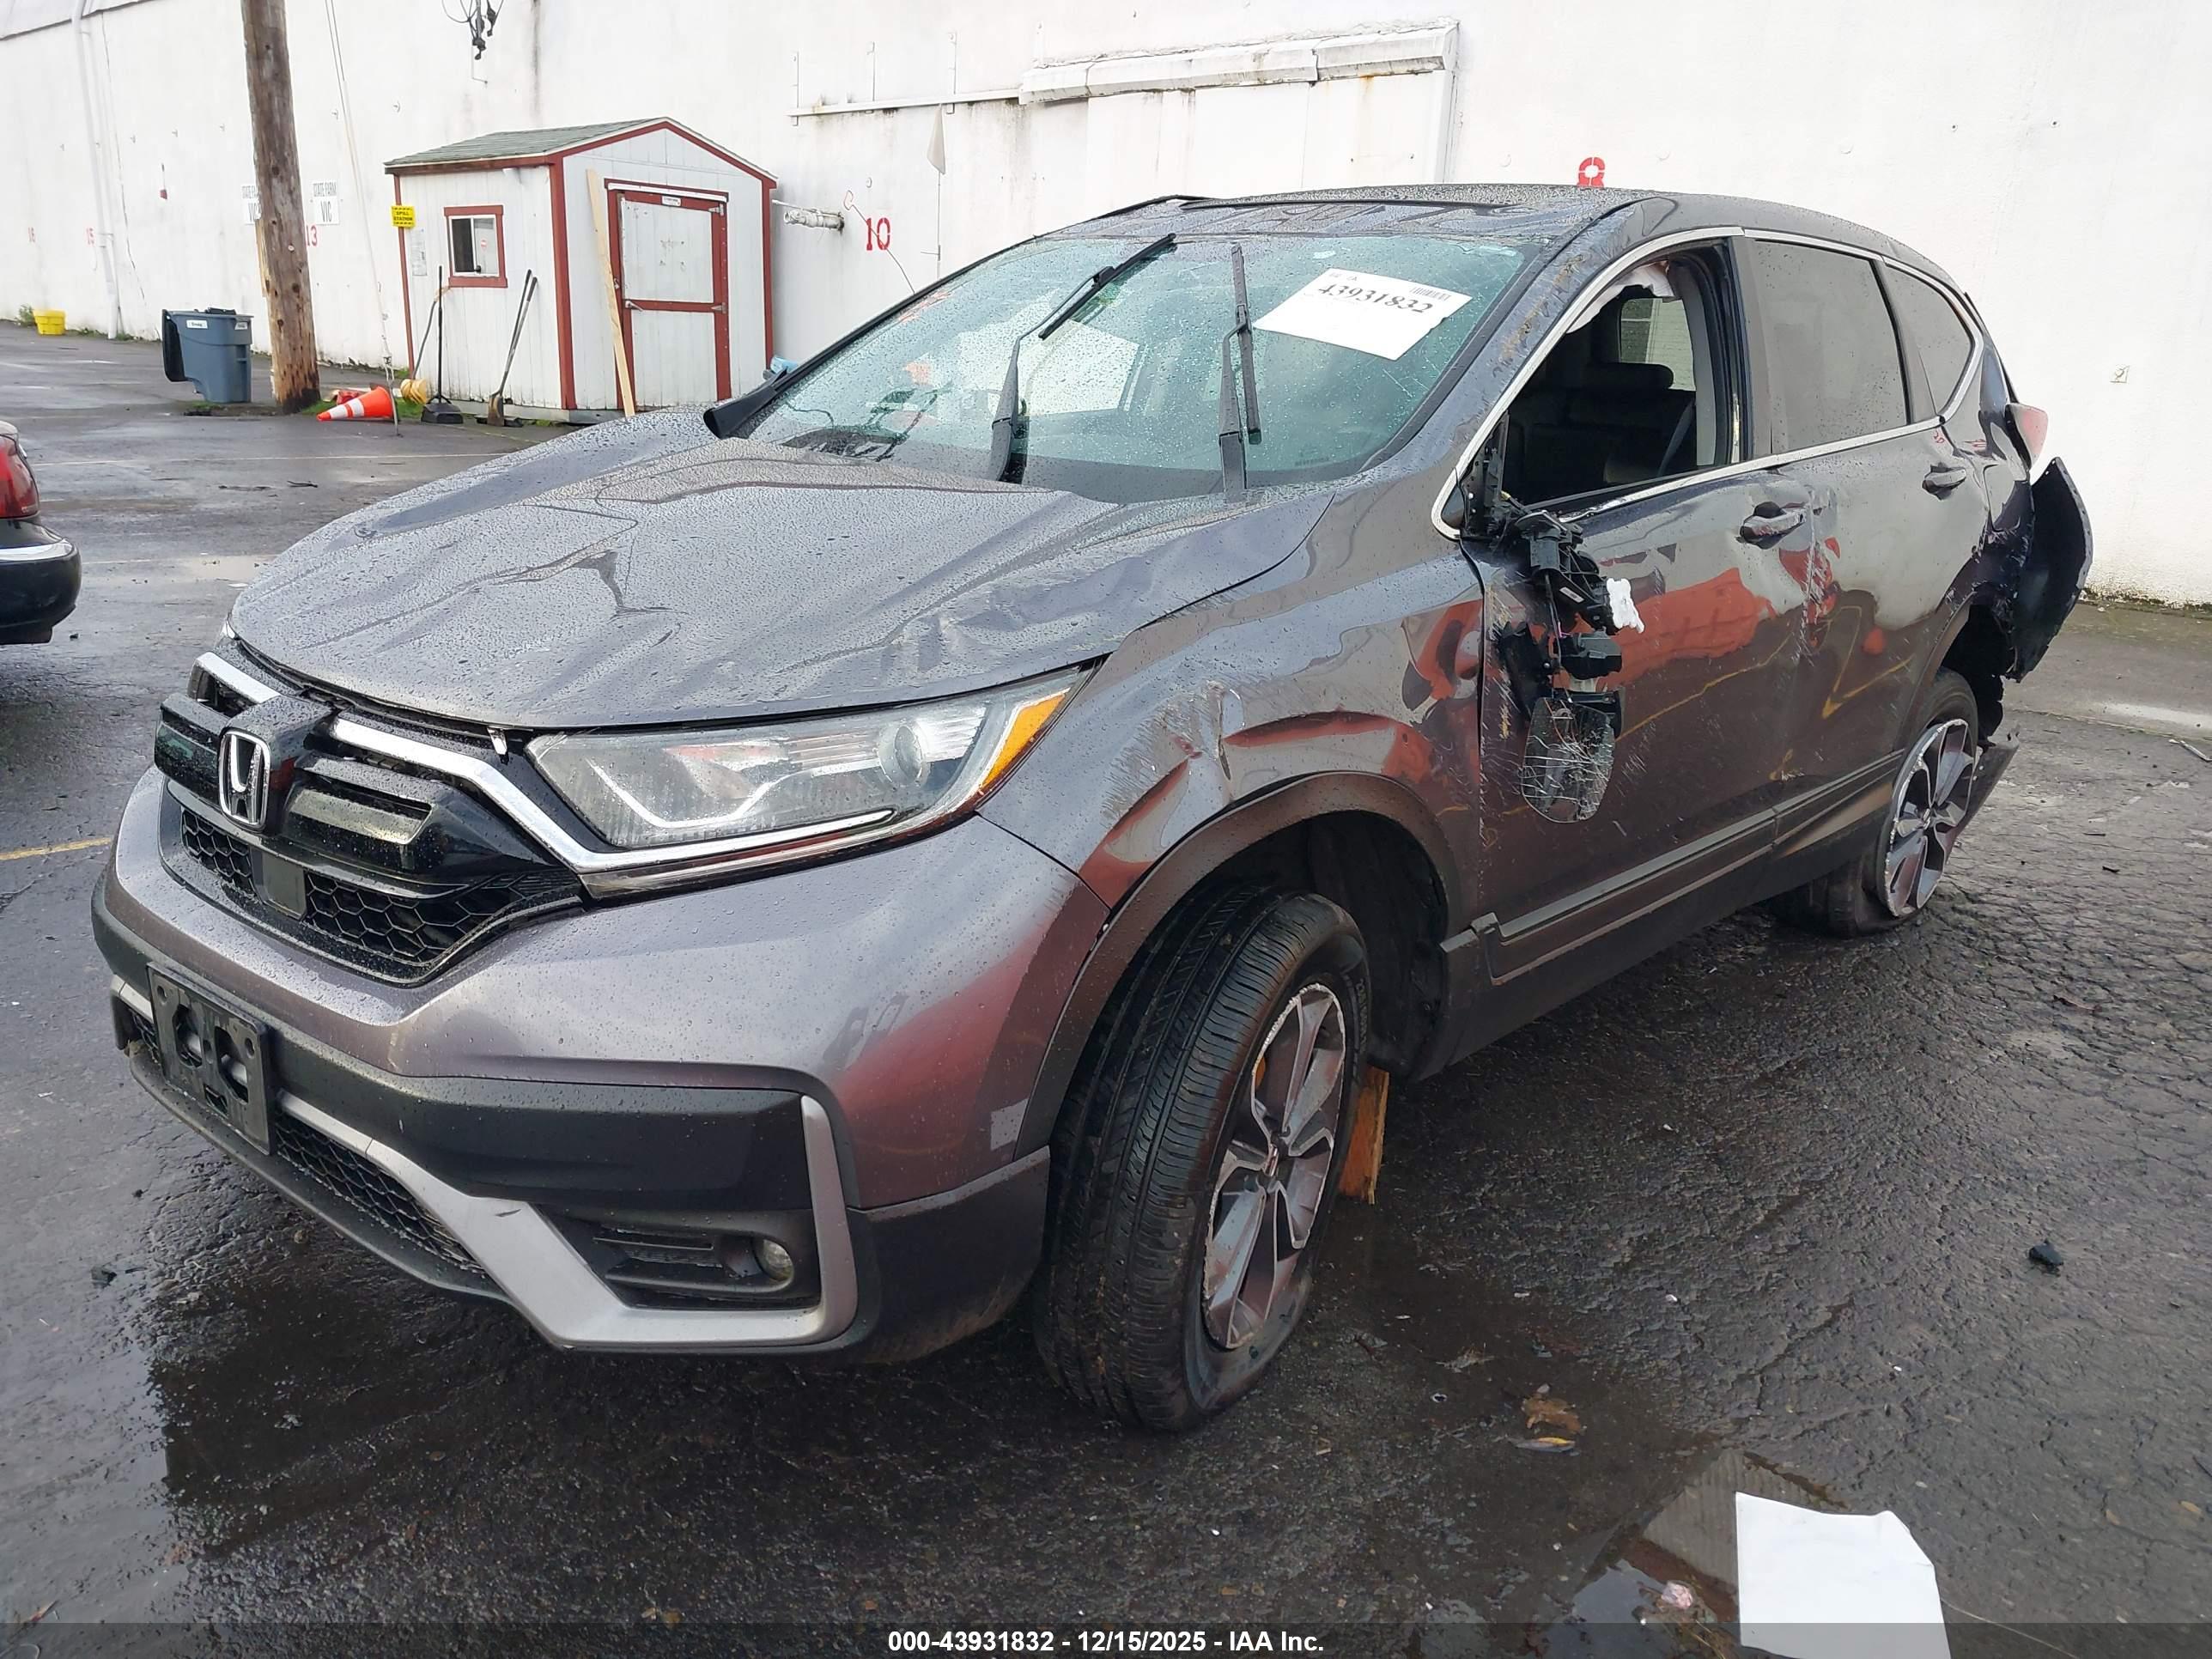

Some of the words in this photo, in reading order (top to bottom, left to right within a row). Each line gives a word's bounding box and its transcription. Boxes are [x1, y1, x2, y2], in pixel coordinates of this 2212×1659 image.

[320, 200, 332, 222] VIC
[866, 217, 890, 251] 10
[1318, 283, 1433, 313] 43931832
